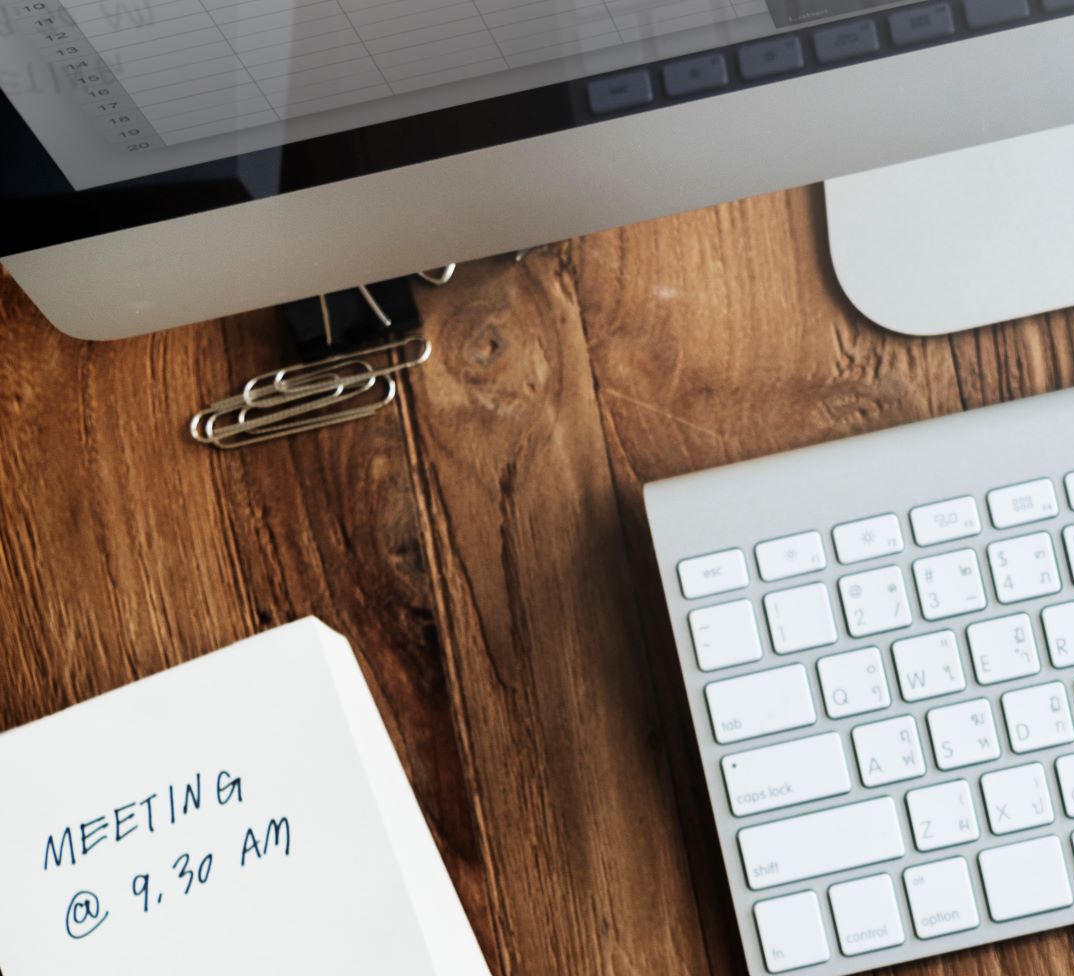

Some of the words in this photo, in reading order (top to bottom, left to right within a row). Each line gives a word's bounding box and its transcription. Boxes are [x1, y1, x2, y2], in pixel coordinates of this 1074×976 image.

[703, 566, 723, 578] esc
[1003, 573, 1015, 591] 4
[928, 591, 940, 610] 3
[854, 608, 866, 626] 2
[1055, 637, 1069, 655] R
[979, 655, 993, 673] E
[907, 670, 927, 689] W
[832, 687, 849, 706] Q
[720, 718, 743, 732] tab
[1015, 723, 1031, 741] D
[941, 740, 955, 759] S
[868, 756, 884, 774] A
[736, 789, 767, 806] caps
[767, 783, 794, 799] lock
[44, 771, 243, 870] MEETING
[995, 803, 1011, 821] X
[919, 820, 936, 839] Z
[754, 860, 780, 877] shift
[66, 891, 109, 939] @
[241, 817, 290, 866] AM
[921, 908, 961, 928] option
[846, 923, 889, 945] control
[771, 946, 785, 960] fn
